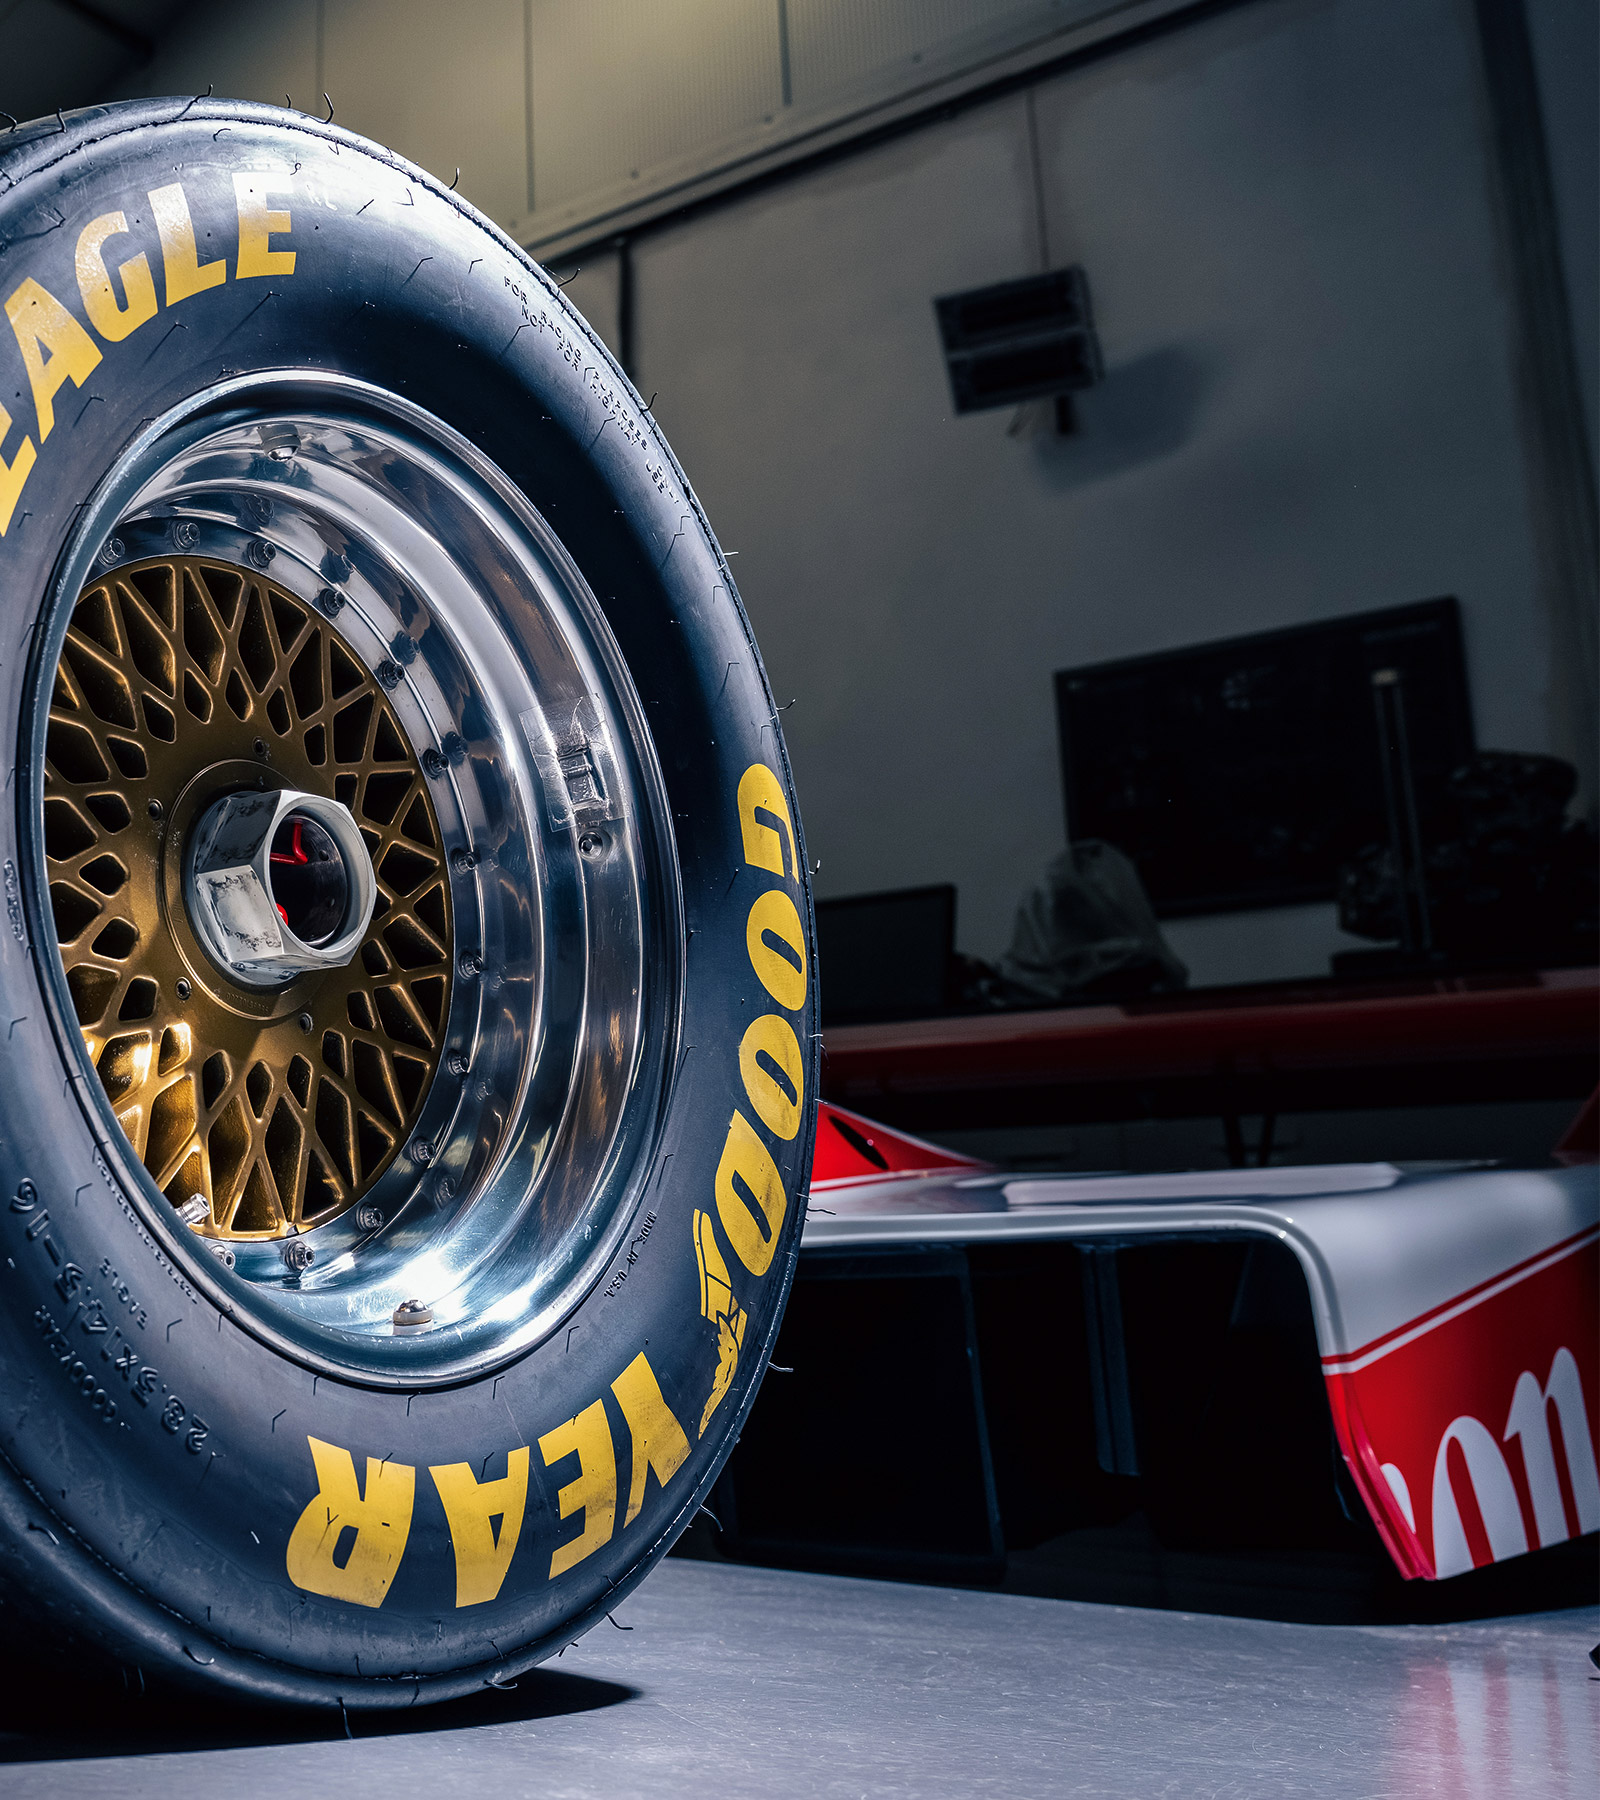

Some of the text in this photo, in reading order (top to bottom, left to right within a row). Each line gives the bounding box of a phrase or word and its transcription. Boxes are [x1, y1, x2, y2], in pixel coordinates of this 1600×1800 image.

[503, 275, 528, 305] FOR
[540, 309, 582, 362] RACING
[521, 304, 545, 333] NOT
[556, 341, 579, 371] FOR
[627, 1249, 639, 1266] IN
[638, 1209, 658, 1245] MADE
[99, 1255, 149, 1331] EAGLE
[33, 1303, 120, 1424] GOODYEAR
